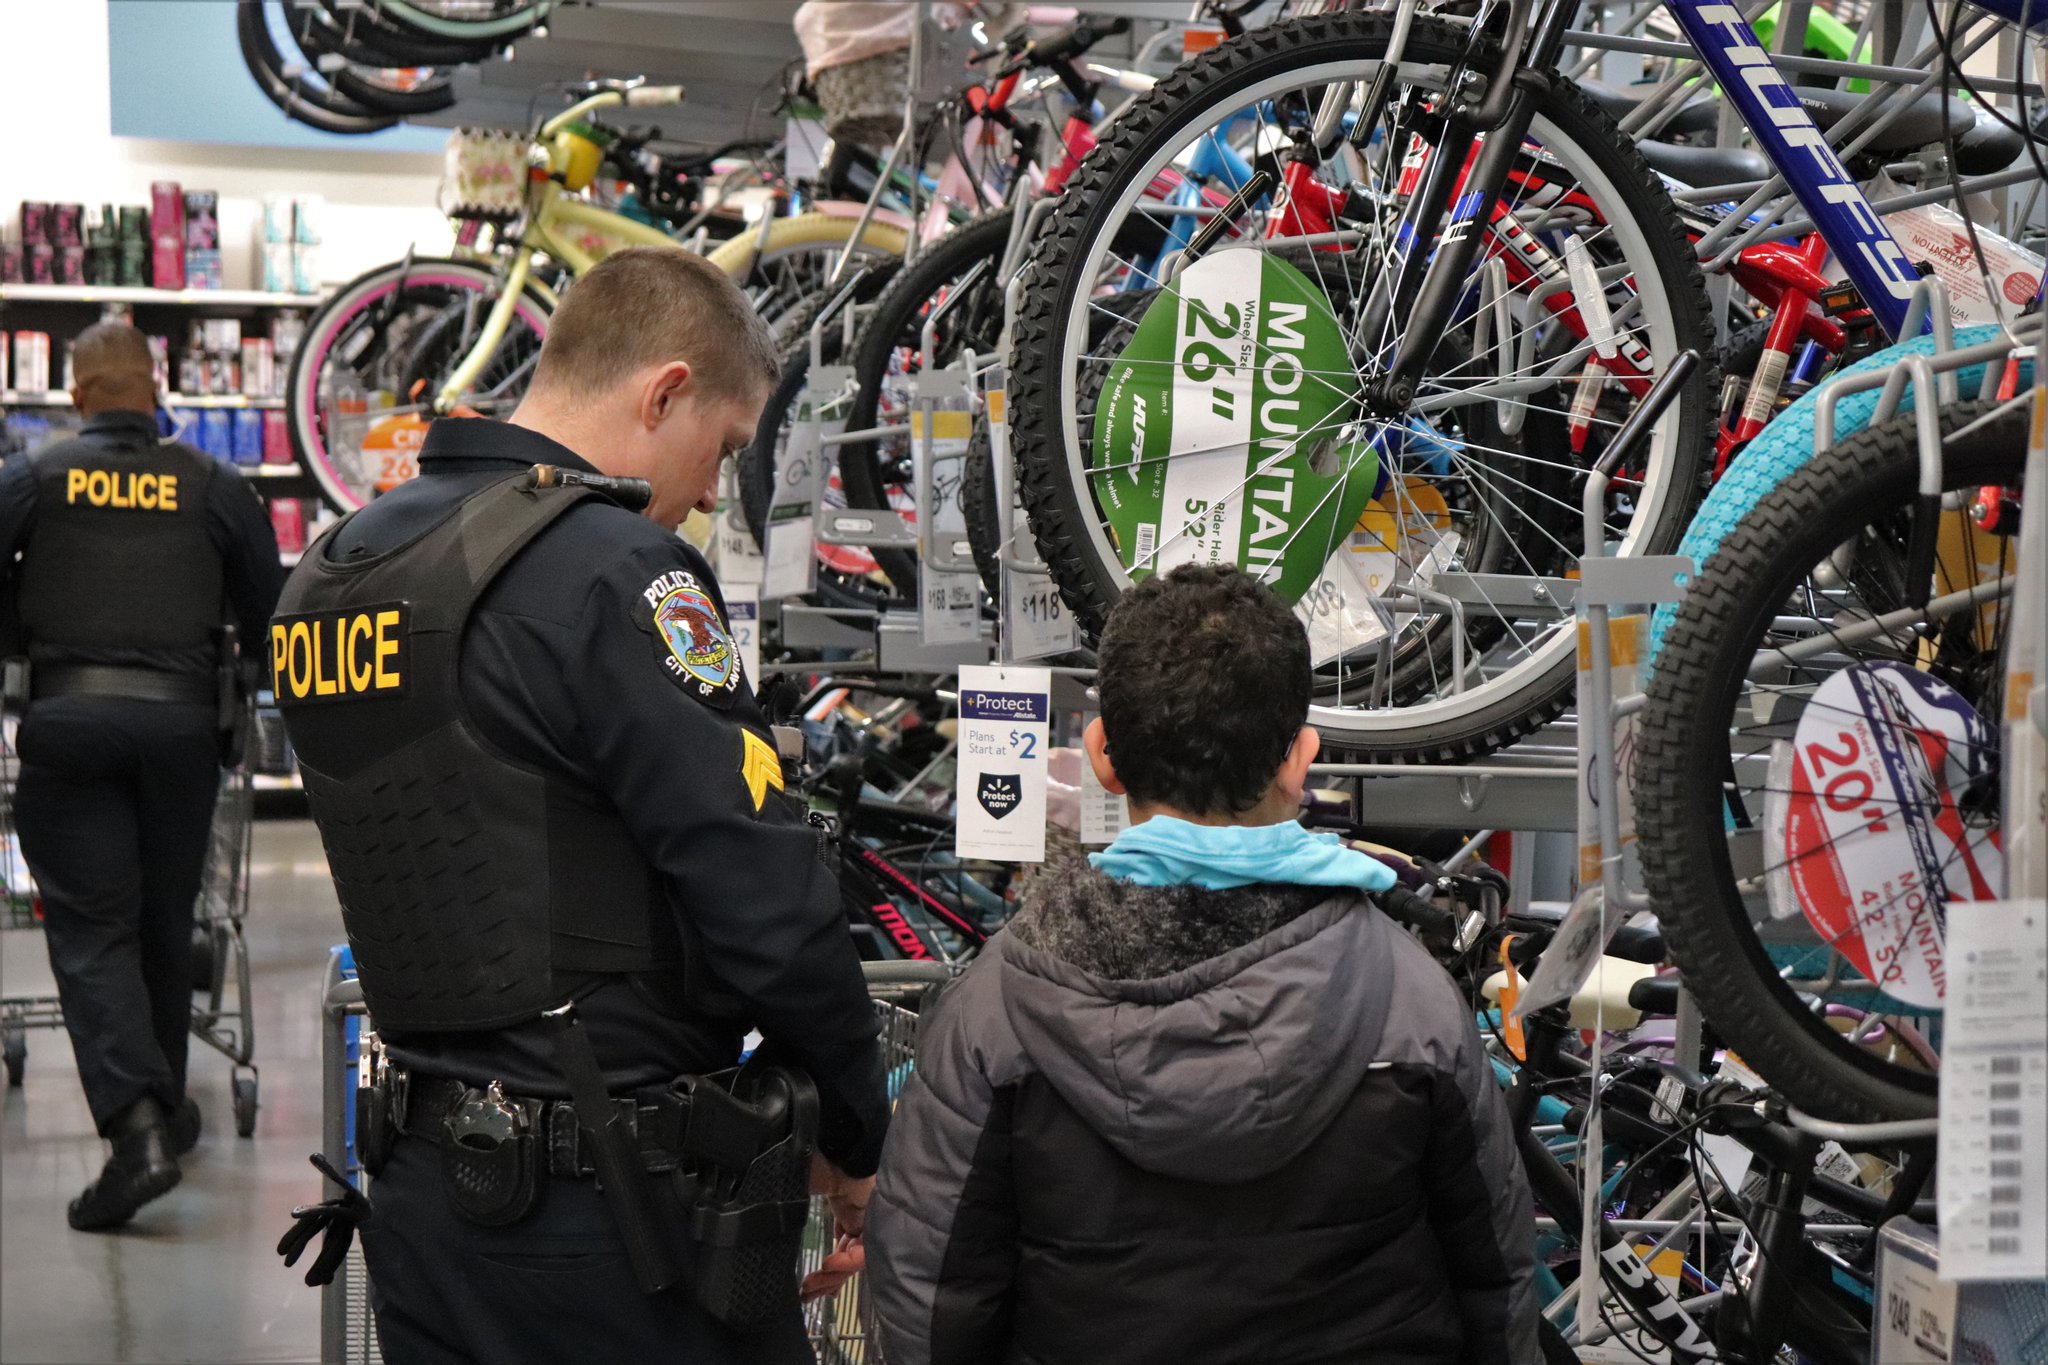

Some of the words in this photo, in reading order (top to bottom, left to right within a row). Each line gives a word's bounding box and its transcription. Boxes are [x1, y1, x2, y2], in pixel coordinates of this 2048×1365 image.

[1695, 4, 1926, 300] HUFFY
[1242, 300, 1256, 341] Wheel
[1183, 297, 1242, 422] 26"
[1240, 344, 1252, 370] Size
[1119, 366, 1134, 384] Bike
[1112, 384, 1122, 401] safe
[1108, 401, 1117, 418] and
[1103, 418, 1115, 449] always
[1127, 393, 1147, 487] HUFFY
[1104, 449, 1112, 472] wea
[1154, 463, 1164, 478] Slot
[67, 468, 178, 512] POLICE
[1106, 479, 1122, 510] helmet
[1151, 488, 1160, 499] 32
[1213, 502, 1226, 537] Rider
[644, 570, 701, 609] POLICE
[1023, 592, 1060, 623] $118
[271, 610, 400, 699] POLICE
[664, 654, 693, 684] CITY
[698, 682, 714, 697] OF
[968, 742, 994, 755] Start
[995, 745, 1007, 756] at
[969, 730, 996, 743] Plans
[1009, 729, 1037, 759] $2
[1805, 731, 1889, 833] 20"
[1867, 758, 1883, 784] Size
[982, 790, 1017, 802] Protect
[988, 800, 1009, 809] now
